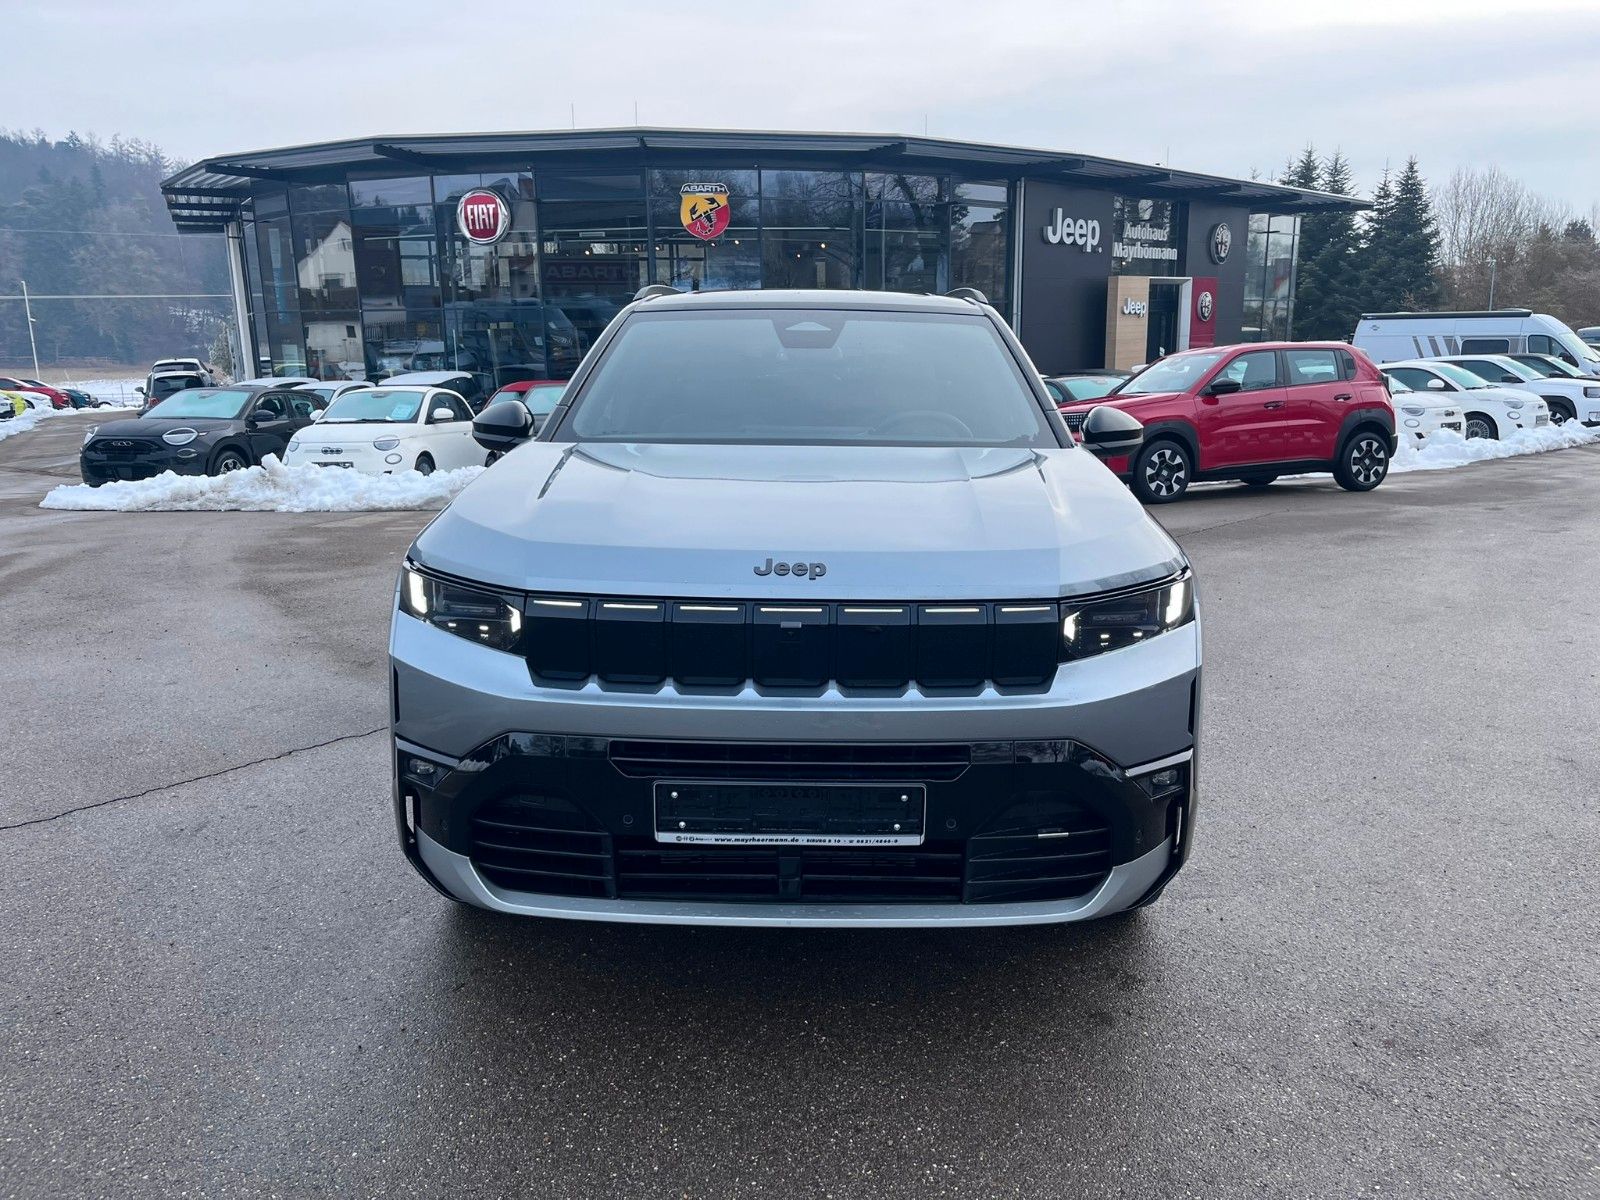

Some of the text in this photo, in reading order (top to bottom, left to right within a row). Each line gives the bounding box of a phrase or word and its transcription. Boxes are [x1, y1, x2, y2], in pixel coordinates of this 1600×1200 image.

[466, 203, 496, 230] FIAT
[1123, 222, 1170, 241] Autohaus
[1112, 241, 1178, 262] Mayrhörmann
[1123, 297, 1147, 317] Jeep
[753, 558, 827, 580] Jeep
